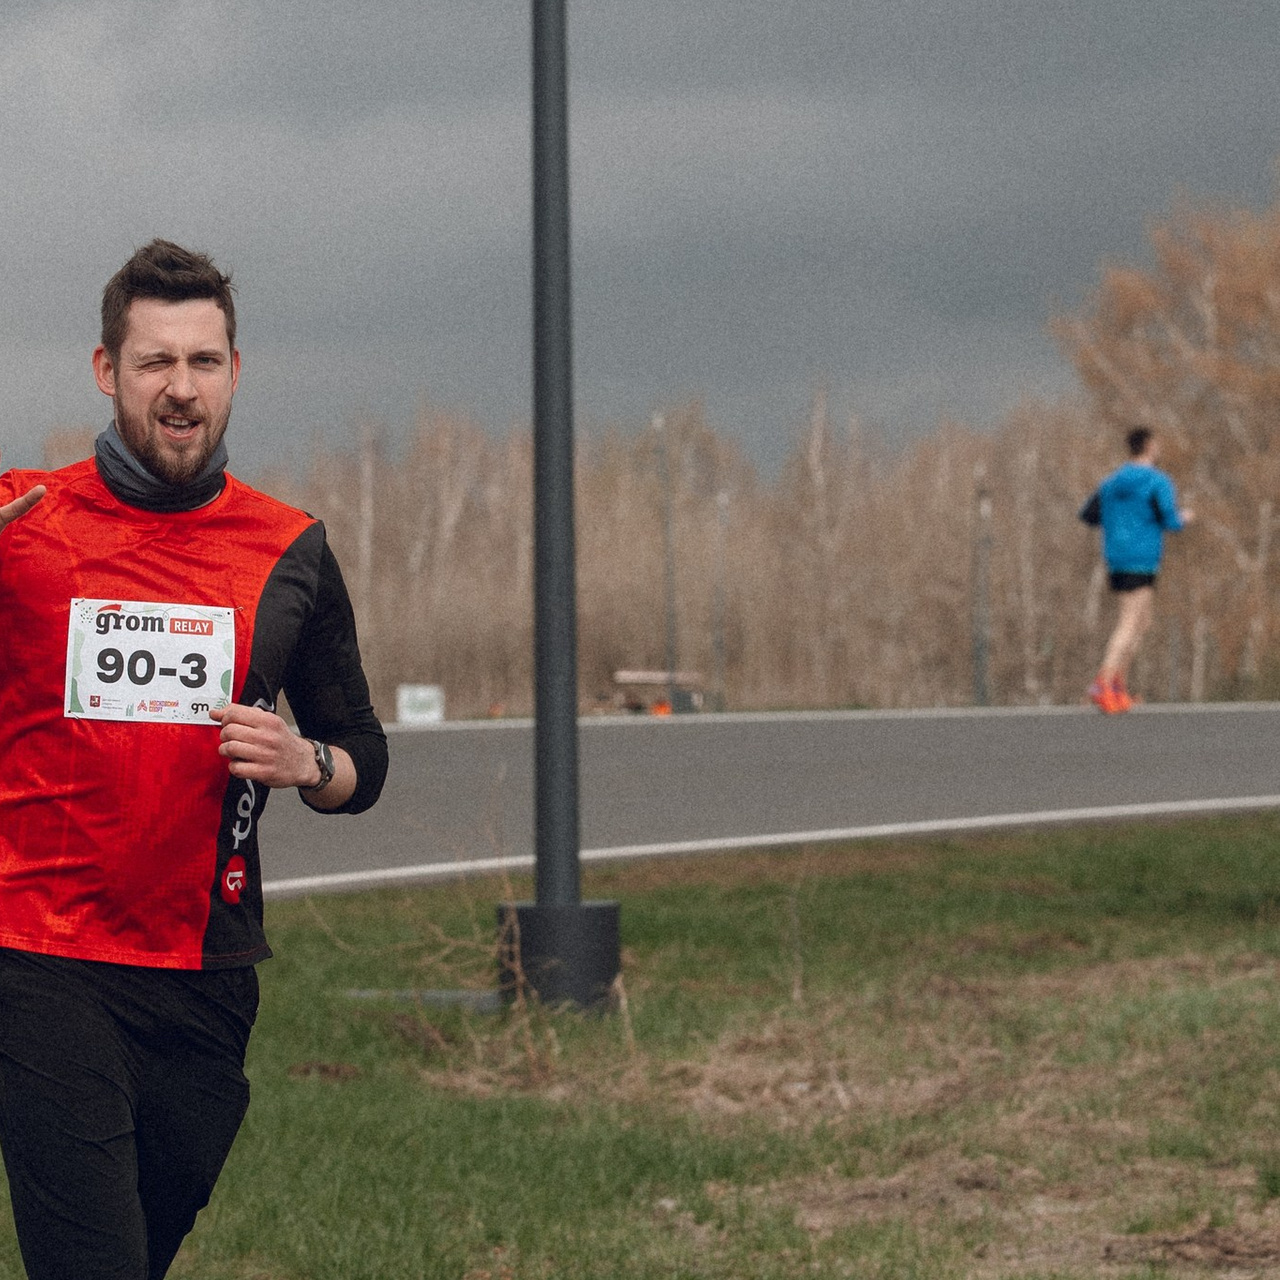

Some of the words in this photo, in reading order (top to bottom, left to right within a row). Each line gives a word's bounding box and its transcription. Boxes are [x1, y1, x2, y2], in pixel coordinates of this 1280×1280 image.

[96, 612, 164, 635] grom
[174, 620, 209, 634] RELAY
[96, 647, 207, 688] 90-3
[191, 702, 209, 715] gm
